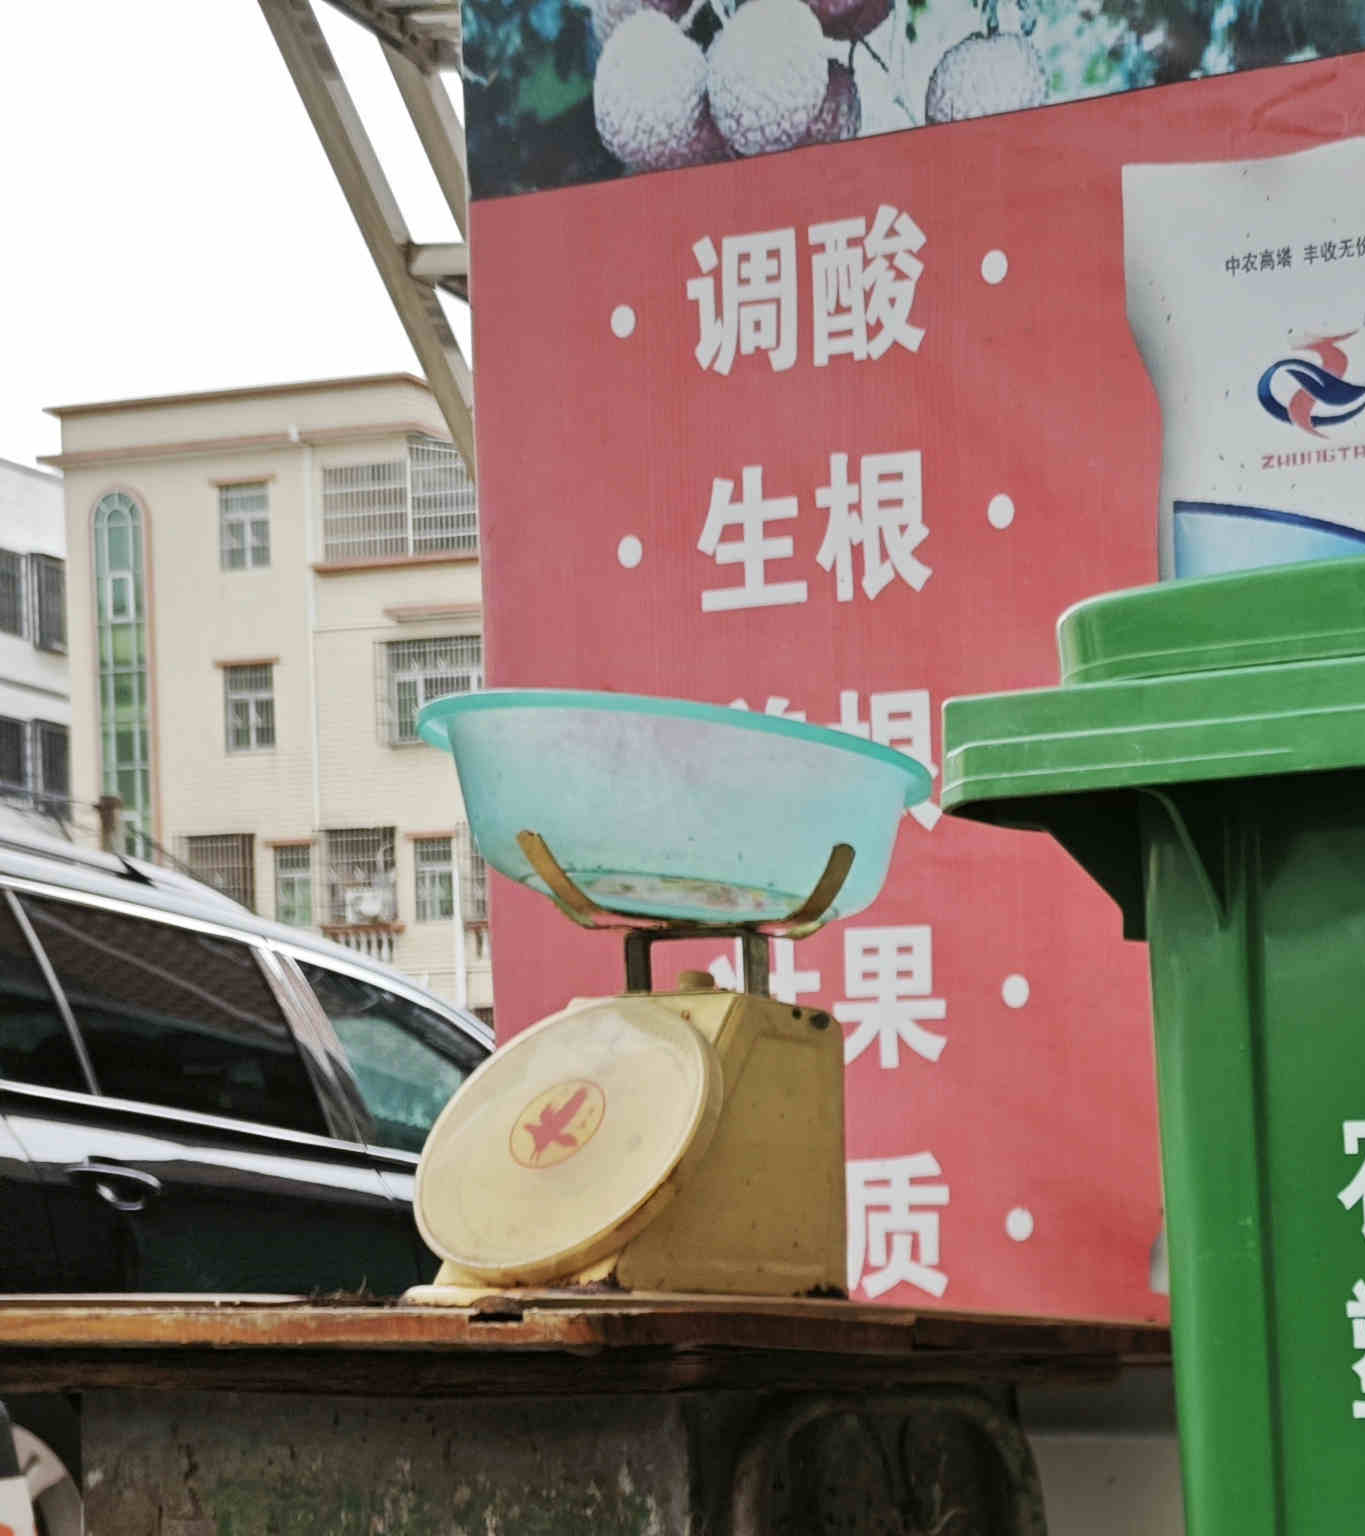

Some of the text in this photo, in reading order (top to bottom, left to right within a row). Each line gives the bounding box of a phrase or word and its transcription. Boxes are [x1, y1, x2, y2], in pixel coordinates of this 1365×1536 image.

[686, 204, 928, 376] 调酸
[1225, 246, 1293, 277] 中农高塔
[697, 450, 933, 612] 生根
